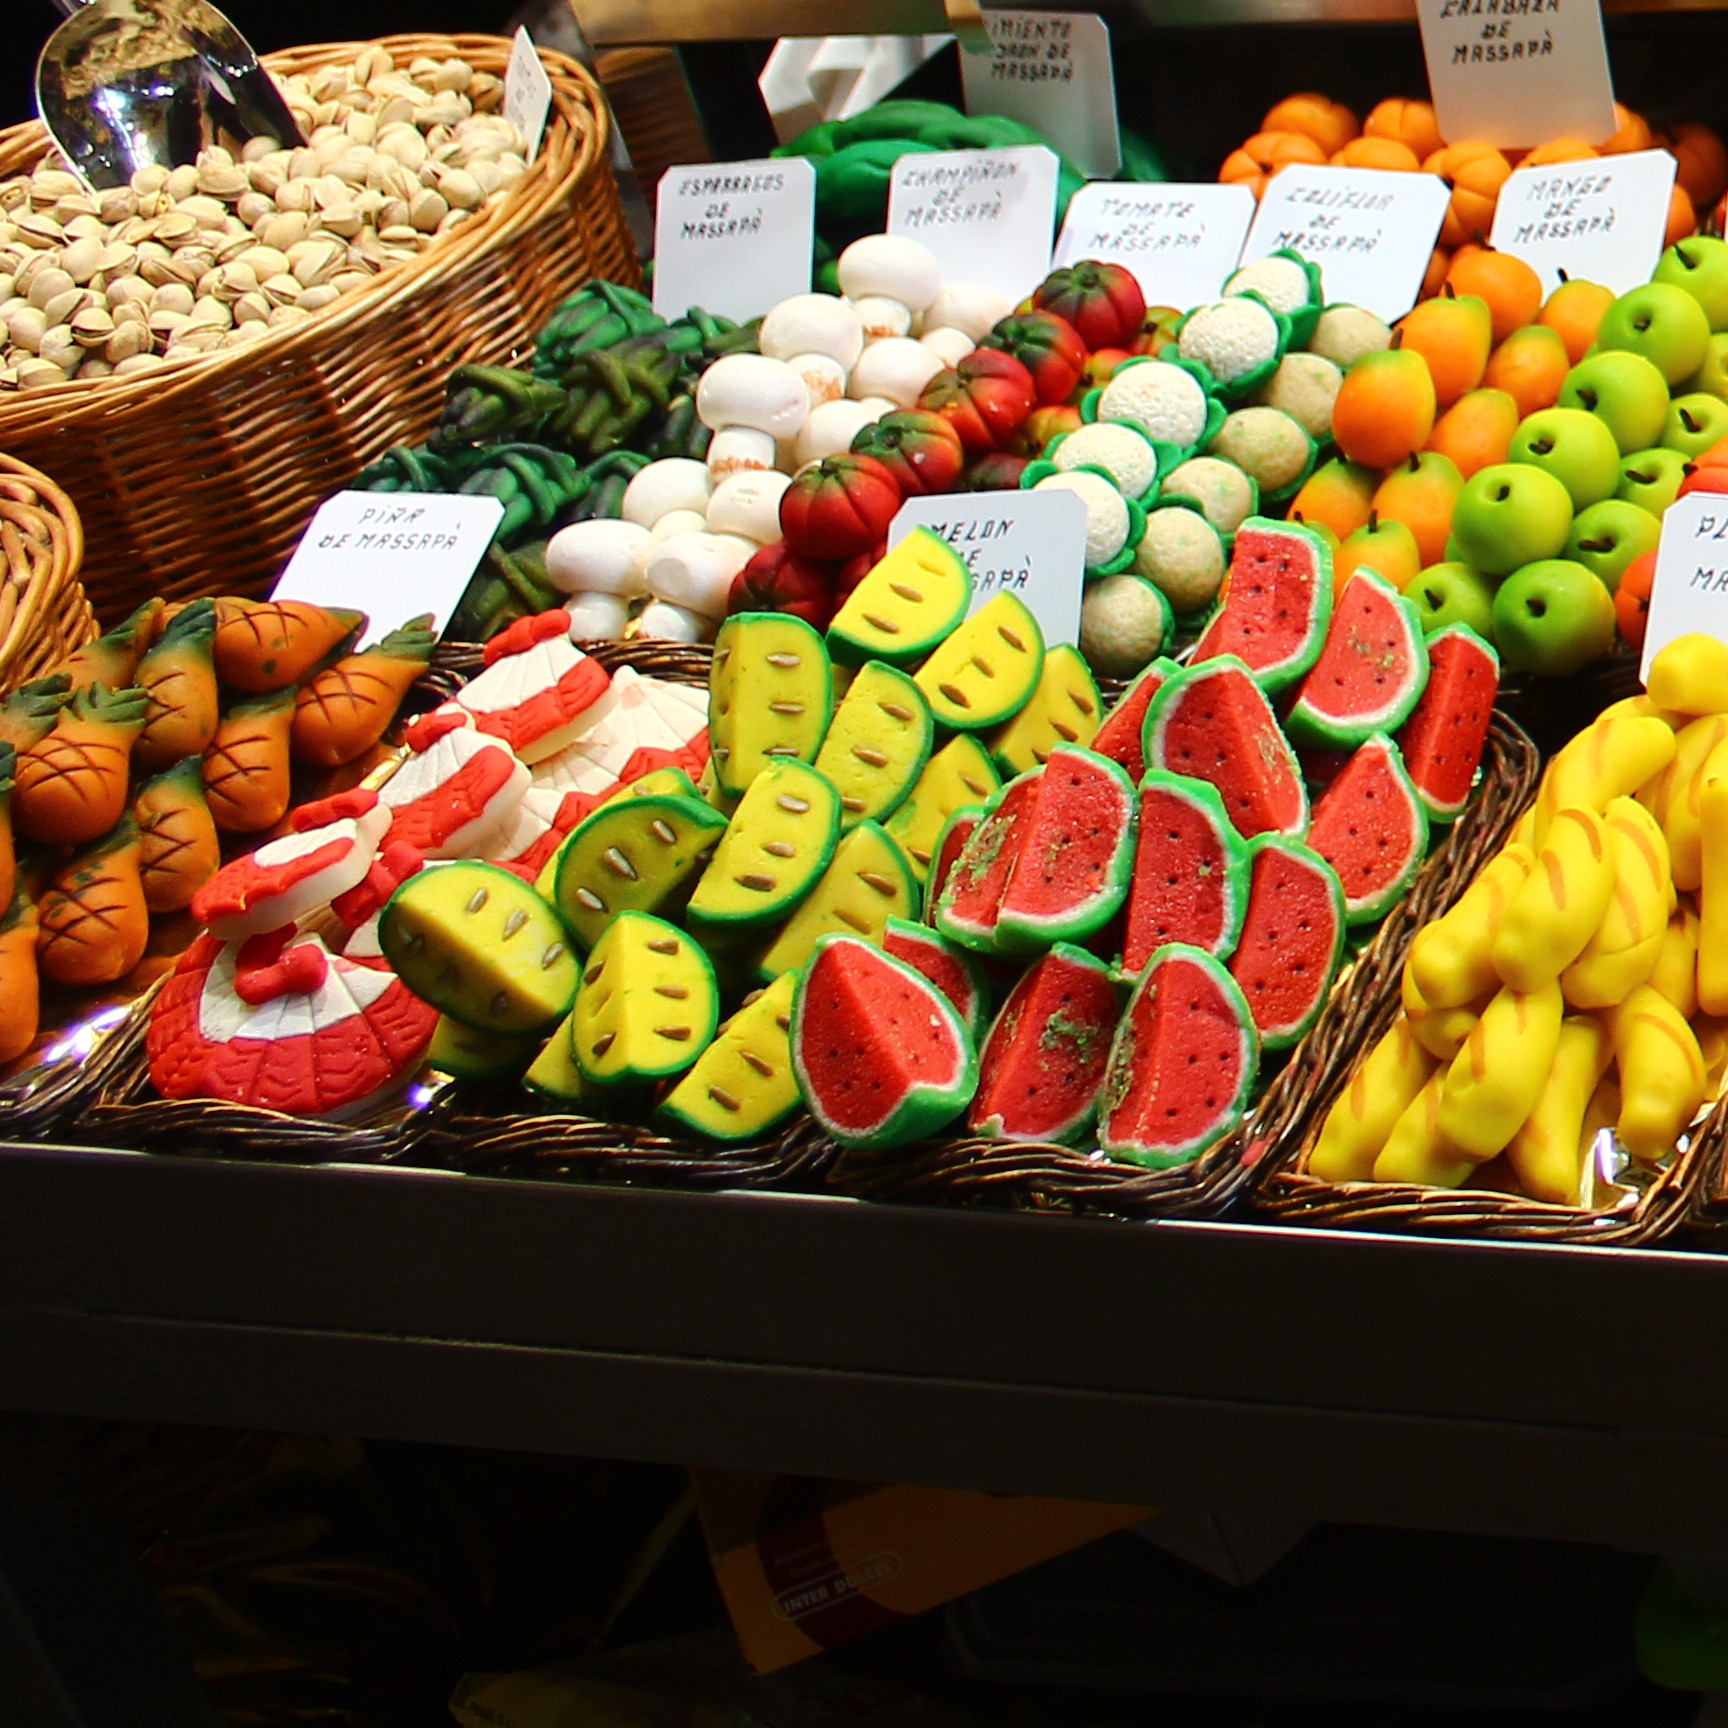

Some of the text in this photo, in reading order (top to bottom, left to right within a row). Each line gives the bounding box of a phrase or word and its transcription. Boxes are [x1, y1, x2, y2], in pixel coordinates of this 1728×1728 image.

[990, 15, 1072, 40] IMIENTO
[1481, 20, 1511, 40] DE
[1452, 30, 1554, 65] MASSAPÀ
[679, 173, 786, 197] ESPARRAGOS
[933, 184, 966, 207] DE
[705, 201, 730, 220] DE
[904, 191, 1003, 229] MASSAPÀ
[1100, 198, 1197, 219] TOMATE
[1544, 198, 1584, 220] DE
[681, 209, 764, 240] MASSAPÀ
[1121, 221, 1156, 238] DE
[1309, 214, 1341, 231] DE
[1513, 206, 1617, 244] MASSAPÀ
[1272, 228, 1384, 254] MASSAPÀ
[318, 521, 462, 551] DE MASSAPÀ
[784, 1585, 829, 1614] INTER
